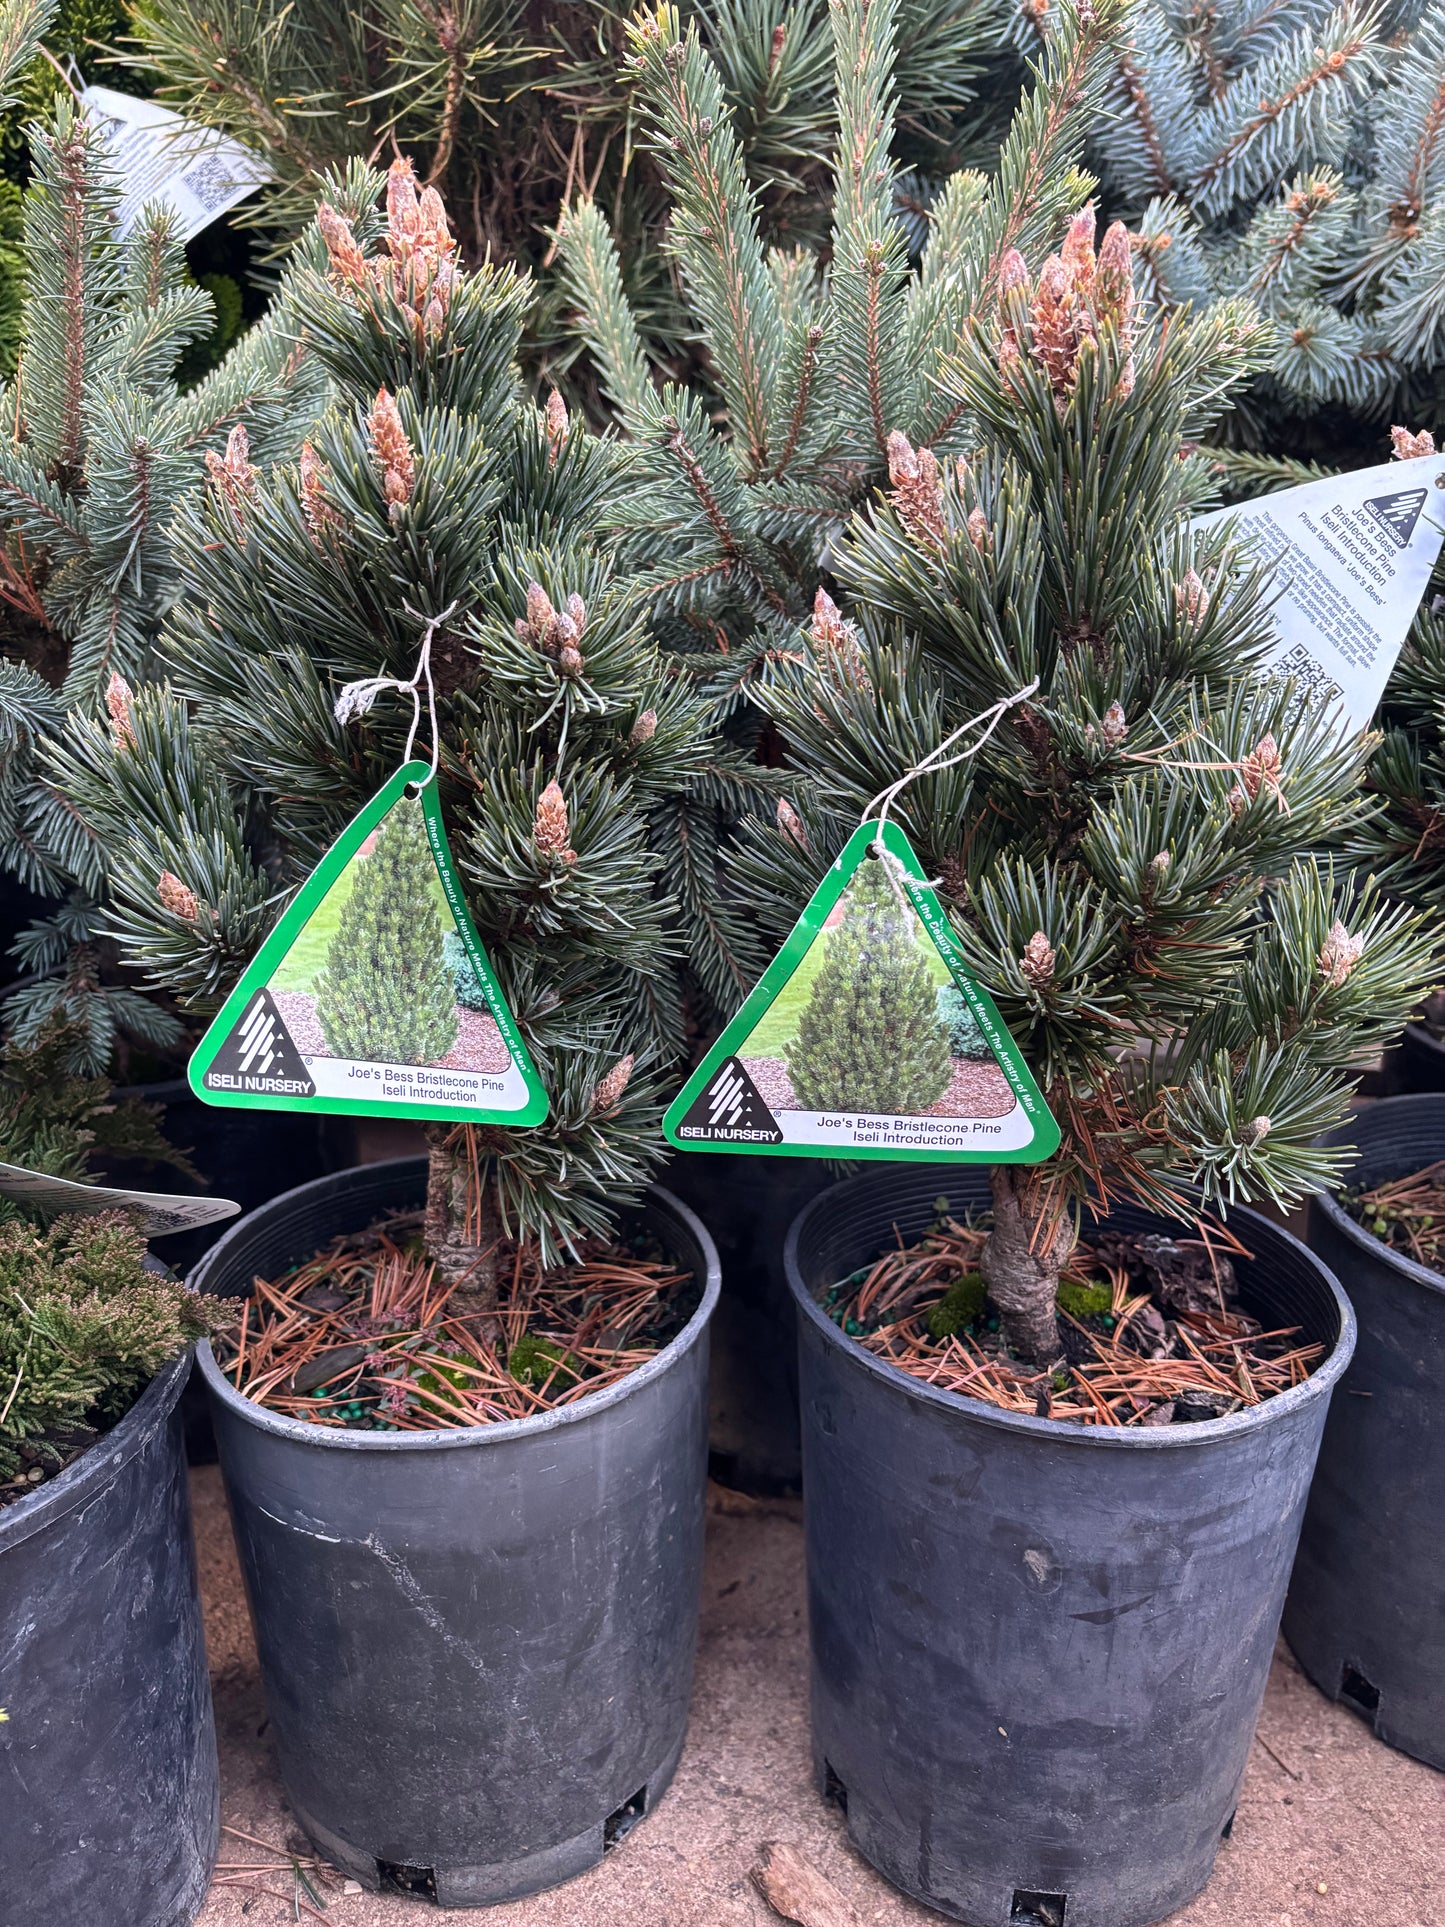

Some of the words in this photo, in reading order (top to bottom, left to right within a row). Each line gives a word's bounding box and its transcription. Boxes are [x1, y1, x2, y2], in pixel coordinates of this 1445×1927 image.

[1320, 512, 1342, 534] Iseli
[1337, 531, 1386, 586] Introduction
[1331, 504, 1377, 556] Bristlecone
[1375, 553, 1396, 577] Pine
[1351, 509, 1376, 534] Joe's
[1374, 531, 1396, 557] Bess
[1365, 501, 1382, 518] ISELI
[1377, 515, 1406, 545] NURSERY
[1252, 515, 1267, 529] most
[1263, 527, 1282, 545] refined
[1288, 554, 1298, 563] we
[1294, 562, 1309, 577] grow.
[1312, 579, 1323, 591] has
[1324, 593, 1347, 618] compact,
[1345, 616, 1364, 637] uniform
[1362, 635, 1378, 652] shape
[1262, 511, 1273, 524] This
[1270, 522, 1293, 547] gorgeous
[1291, 543, 1306, 559] Great
[1302, 555, 1317, 572] Basin
[1315, 569, 1341, 598] Bristlecone
[1339, 595, 1352, 609] Pine
[1353, 613, 1375, 635] possibly
[1372, 633, 1382, 644] the
[1298, 511, 1318, 534] Pinus
[1316, 531, 1347, 565] longaeva
[1347, 562, 1367, 587] 'Joe's
[1364, 584, 1387, 605] Bess'
[1252, 527, 1266, 543] dese
[1286, 564, 1312, 590] two-toned
[1308, 588, 1328, 609] needles
[1326, 607, 1338, 619] that
[1335, 617, 1352, 636] radiate
[1350, 635, 1369, 654] around
[1366, 651, 1376, 662] the
[1292, 596, 1301, 605] no
[1297, 603, 1318, 625] pruning,
[1316, 622, 1327, 633] but
[1324, 632, 1340, 648] wants
[1338, 646, 1349, 656] full
[1345, 655, 1357, 668] sun.
[1305, 598, 1333, 629] appearance.
[1333, 626, 1343, 639] The
[1341, 637, 1359, 657] formal,
[428, 817, 440, 848] Where
[436, 851, 445, 867] the
[442, 870, 457, 903] Beauty
[454, 906, 463, 915] of
[459, 919, 475, 950] Nature
[472, 953, 487, 981] Meets
[485, 983, 495, 1001] The
[492, 1004, 511, 1036] Artistry
[509, 1039, 518, 1048] of
[920, 903, 932, 920] the
[929, 921, 952, 954] Beauty
[949, 957, 961, 969] of
[974, 1003, 993, 1031] Meets
[990, 1032, 1002, 1049] The
[998, 1052, 1020, 1082] Artistry
[1016, 1084, 1028, 1092] of
[208, 1073, 242, 1089] ISELI
[245, 1076, 312, 1094] NURSERY
[348, 1066, 381, 1080] Joe's
[384, 1069, 414, 1083] Bess
[417, 1073, 479, 1089] Bristlecone
[481, 1078, 505, 1091] Pine
[382, 1083, 406, 1097] Iseli
[409, 1086, 477, 1102] Introduction
[680, 1127, 712, 1138] ISELI
[714, 1128, 778, 1141] NURSERY
[817, 1117, 853, 1128] Joe's
[857, 1119, 890, 1130] Bess
[894, 1120, 969, 1133] Bristlecone
[972, 1123, 1002, 1134] Pine
[853, 1131, 879, 1142] Iseli
[883, 1133, 963, 1145] Introduction
